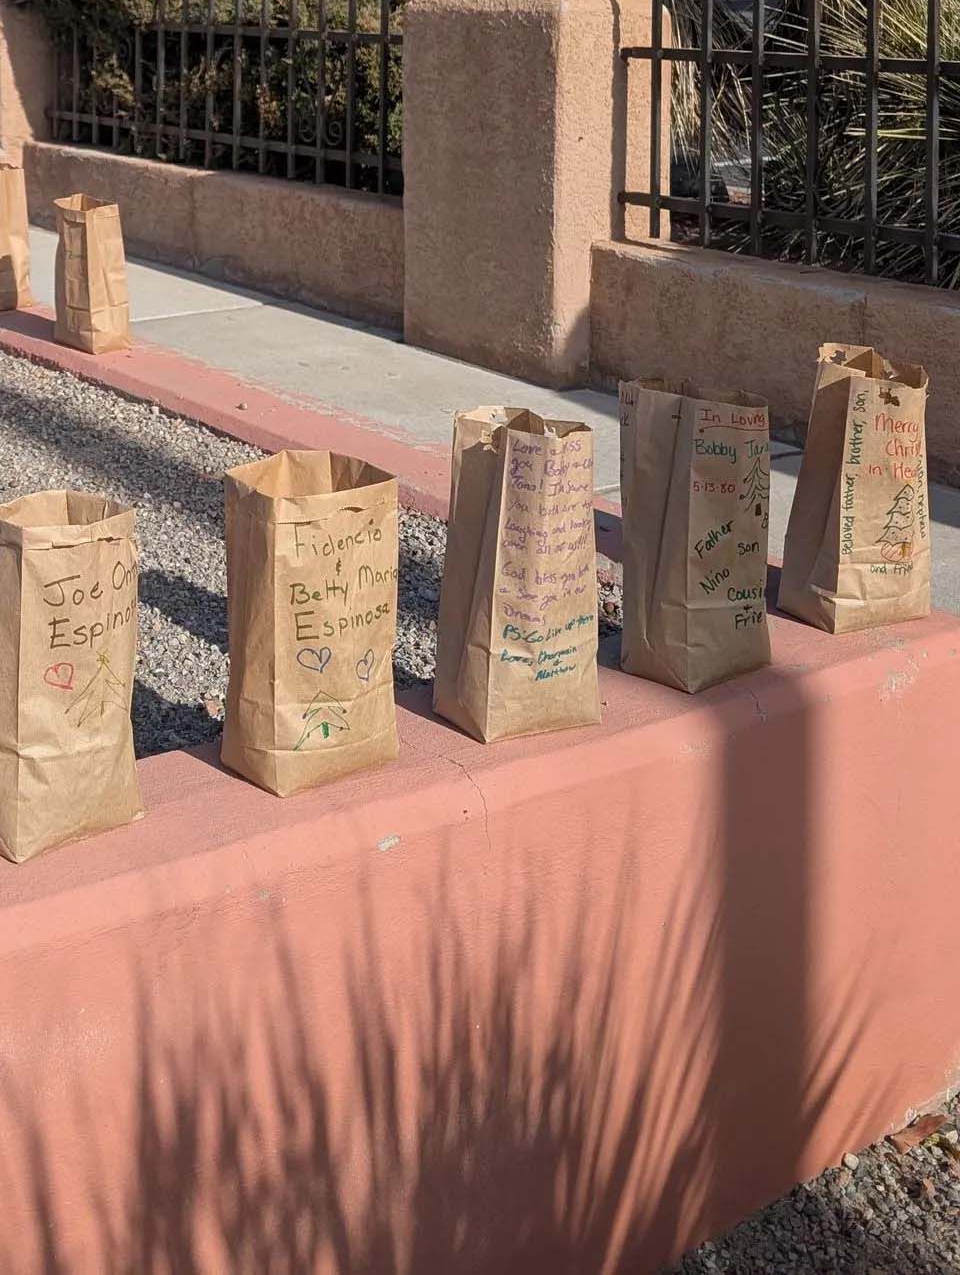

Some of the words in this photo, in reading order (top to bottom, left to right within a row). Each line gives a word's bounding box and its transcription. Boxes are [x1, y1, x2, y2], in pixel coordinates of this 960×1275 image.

[699, 408, 721, 423] In
[875, 413, 920, 442] Merry
[693, 438, 737, 465] Bobby
[293, 518, 382, 558] Fidencio
[695, 520, 734, 559] Father
[841, 516, 855, 555] Beloved
[43, 574, 103, 607] Joe
[289, 578, 348, 606] Betty
[727, 579, 763, 602] Cousi
[294, 603, 391, 642] Espinosa
[735, 612, 763, 630] Frie
